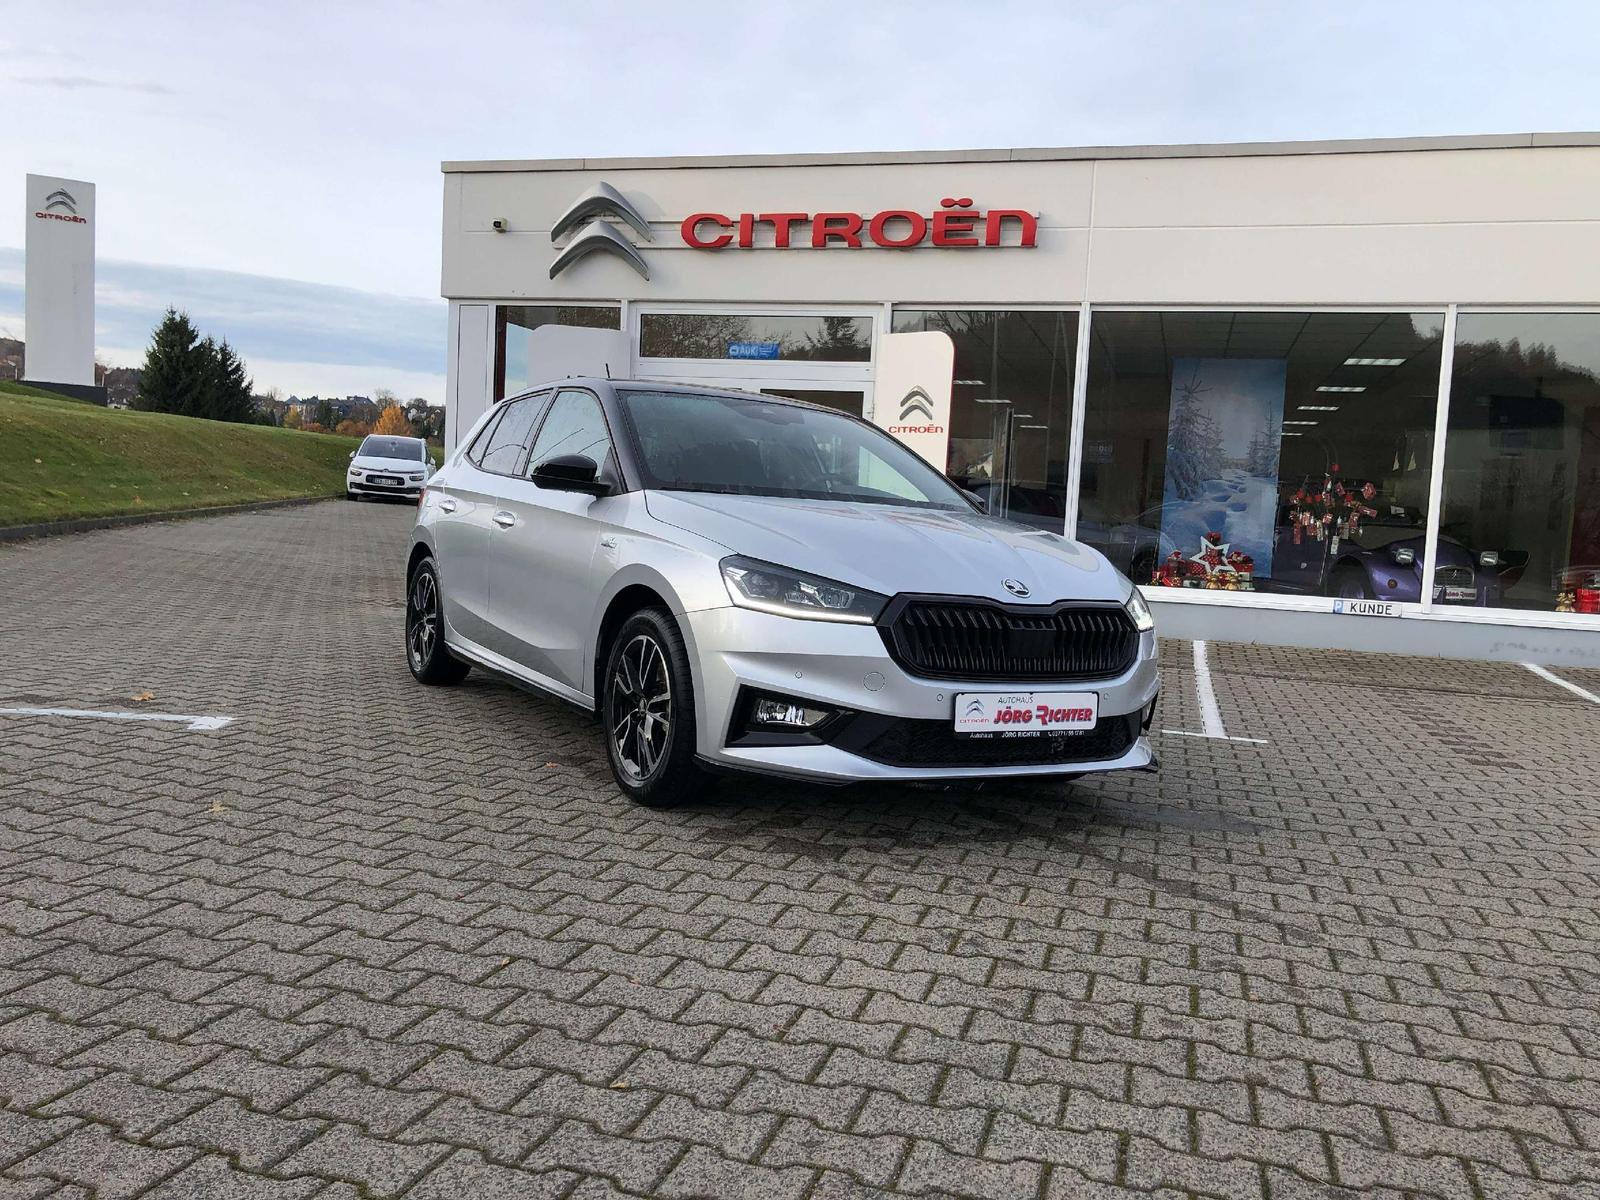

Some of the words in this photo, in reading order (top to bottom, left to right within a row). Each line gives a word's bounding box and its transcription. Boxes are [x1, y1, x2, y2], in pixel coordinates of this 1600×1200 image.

[1350, 602, 1393, 616] KUNDE
[998, 696, 1034, 704] AUTOHAUS
[994, 706, 1033, 725] JÖRG
[1036, 704, 1093, 726] RICHTER
